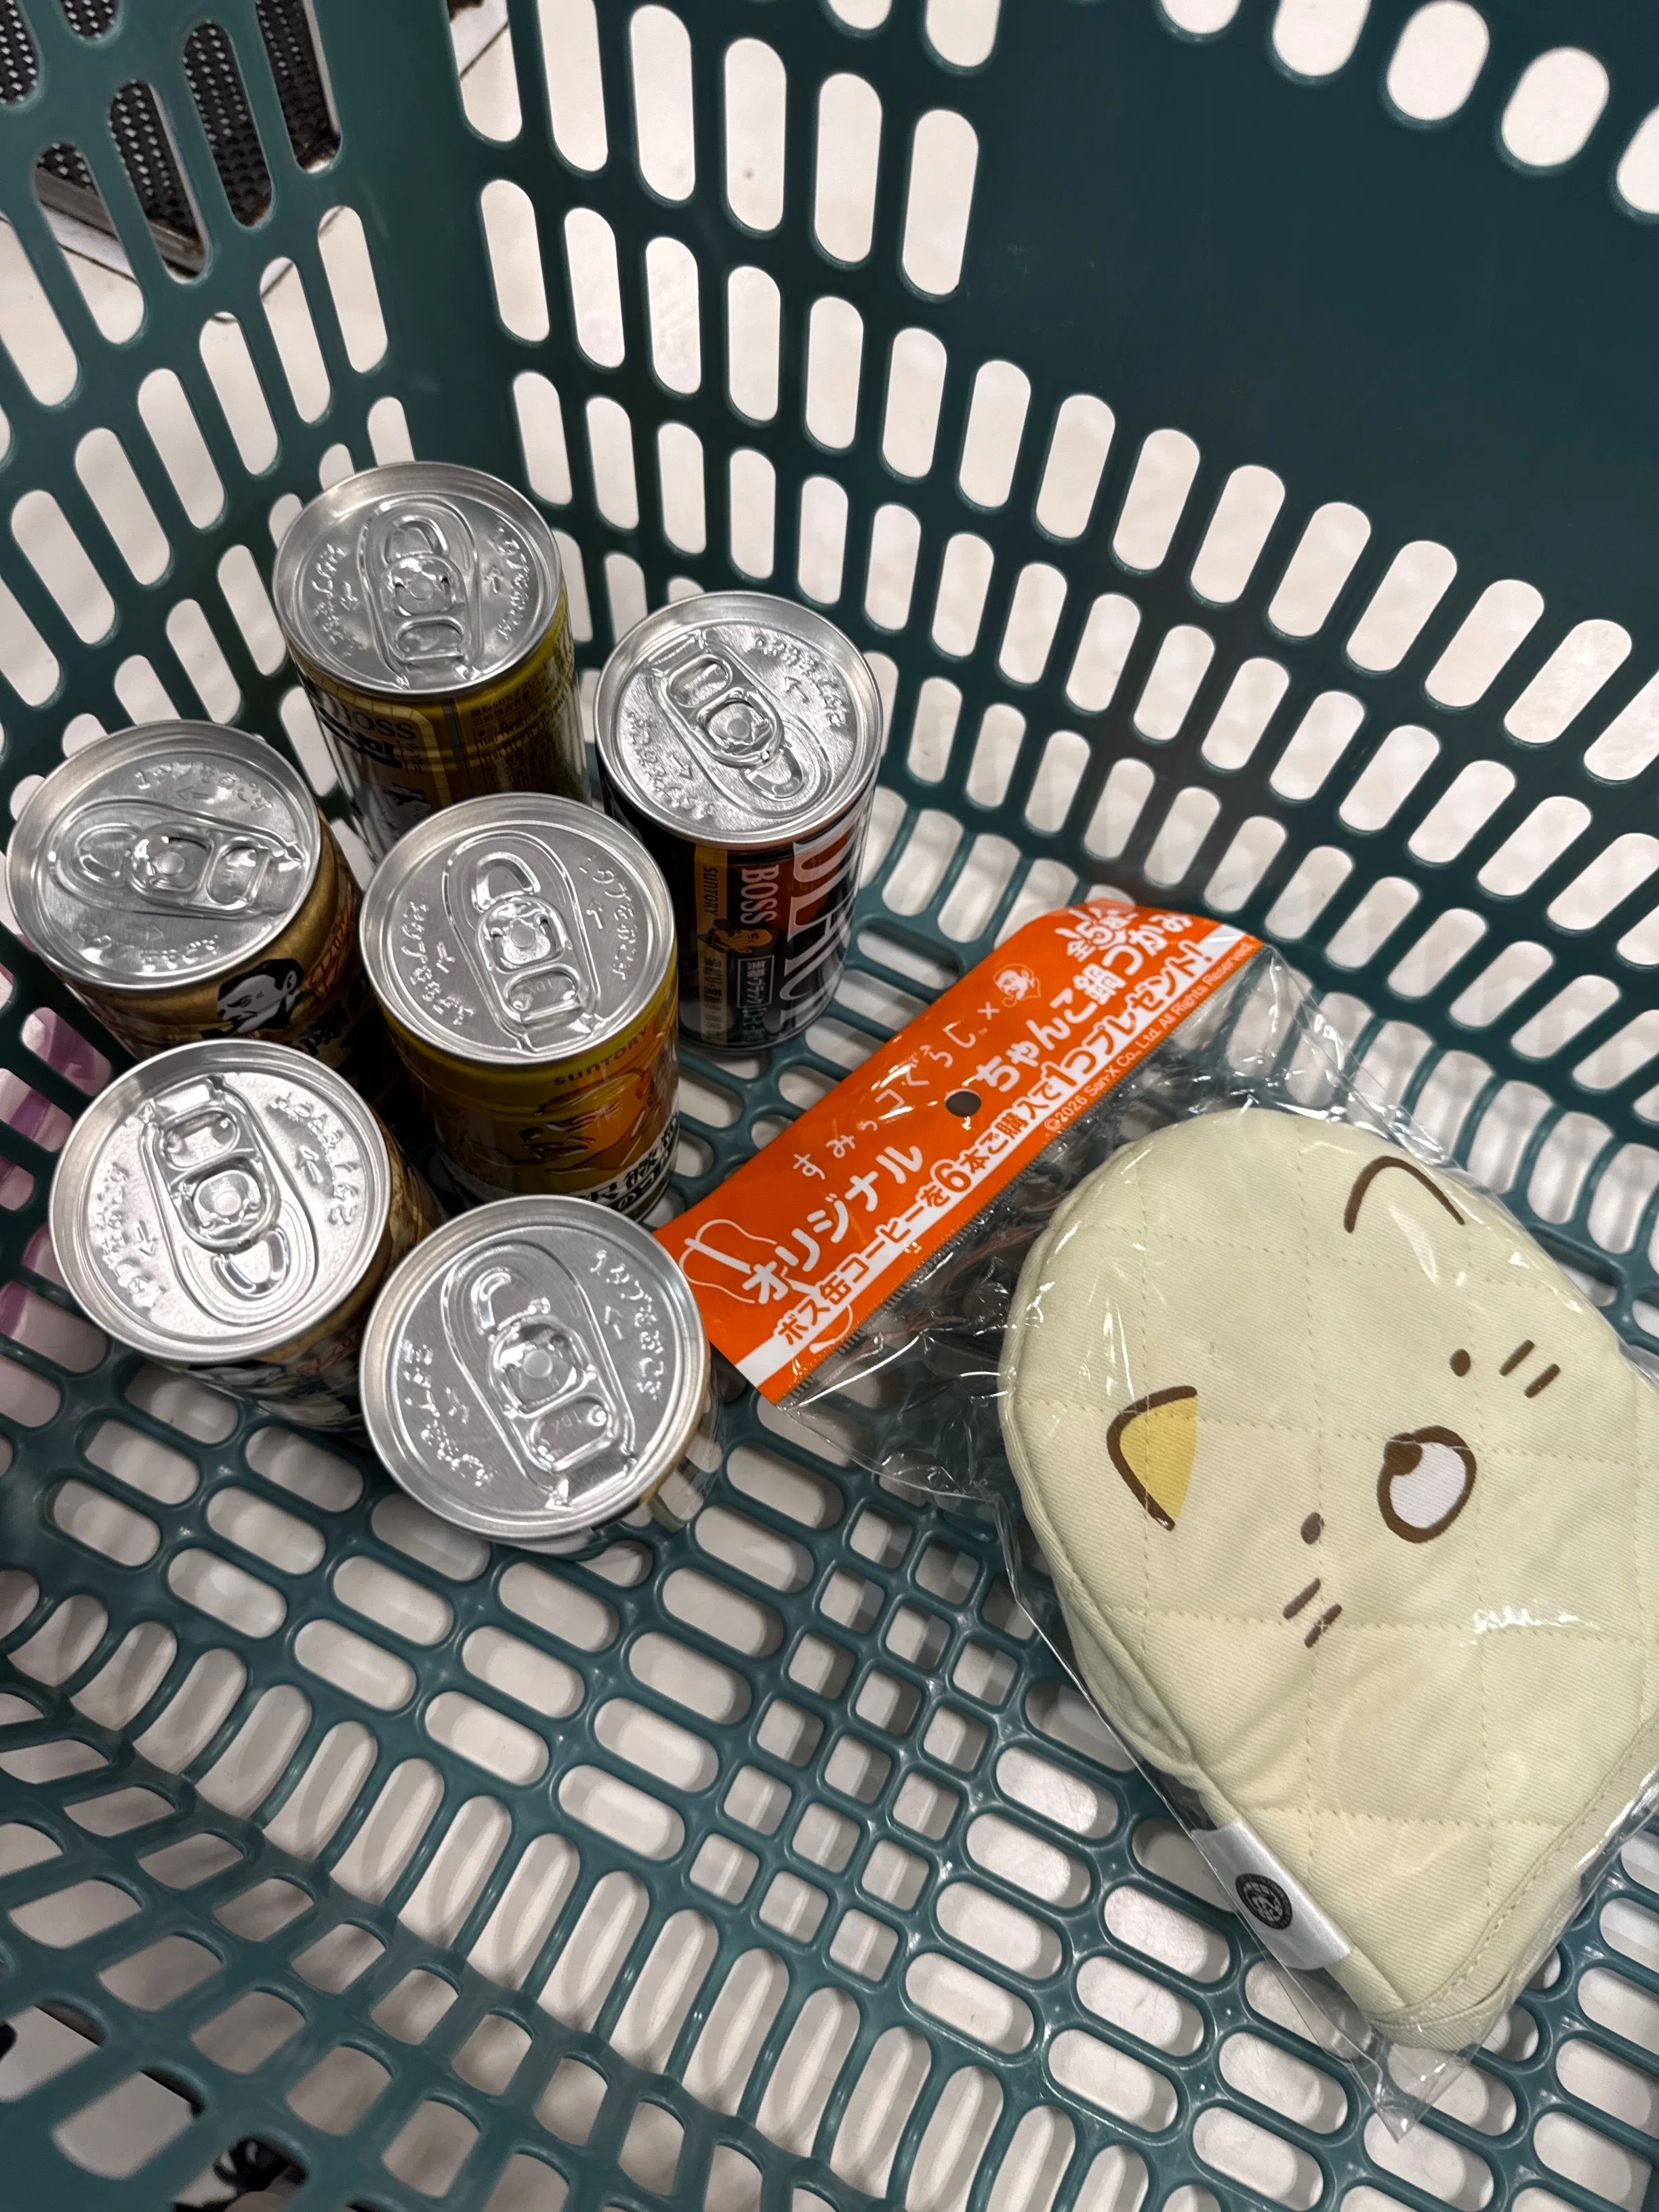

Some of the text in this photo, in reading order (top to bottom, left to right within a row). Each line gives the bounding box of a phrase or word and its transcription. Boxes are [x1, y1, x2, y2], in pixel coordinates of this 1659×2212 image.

[703, 865, 718, 917] SUNTORY
[740, 864, 780, 925] BOSS
[1135, 1026, 1162, 1050] Ltd.
[1159, 1010, 1179, 1029] All
[1172, 986, 1206, 1015] Rights
[553, 1030, 645, 1085] SUNTORY
[741, 1145, 923, 1305] オリジナル
